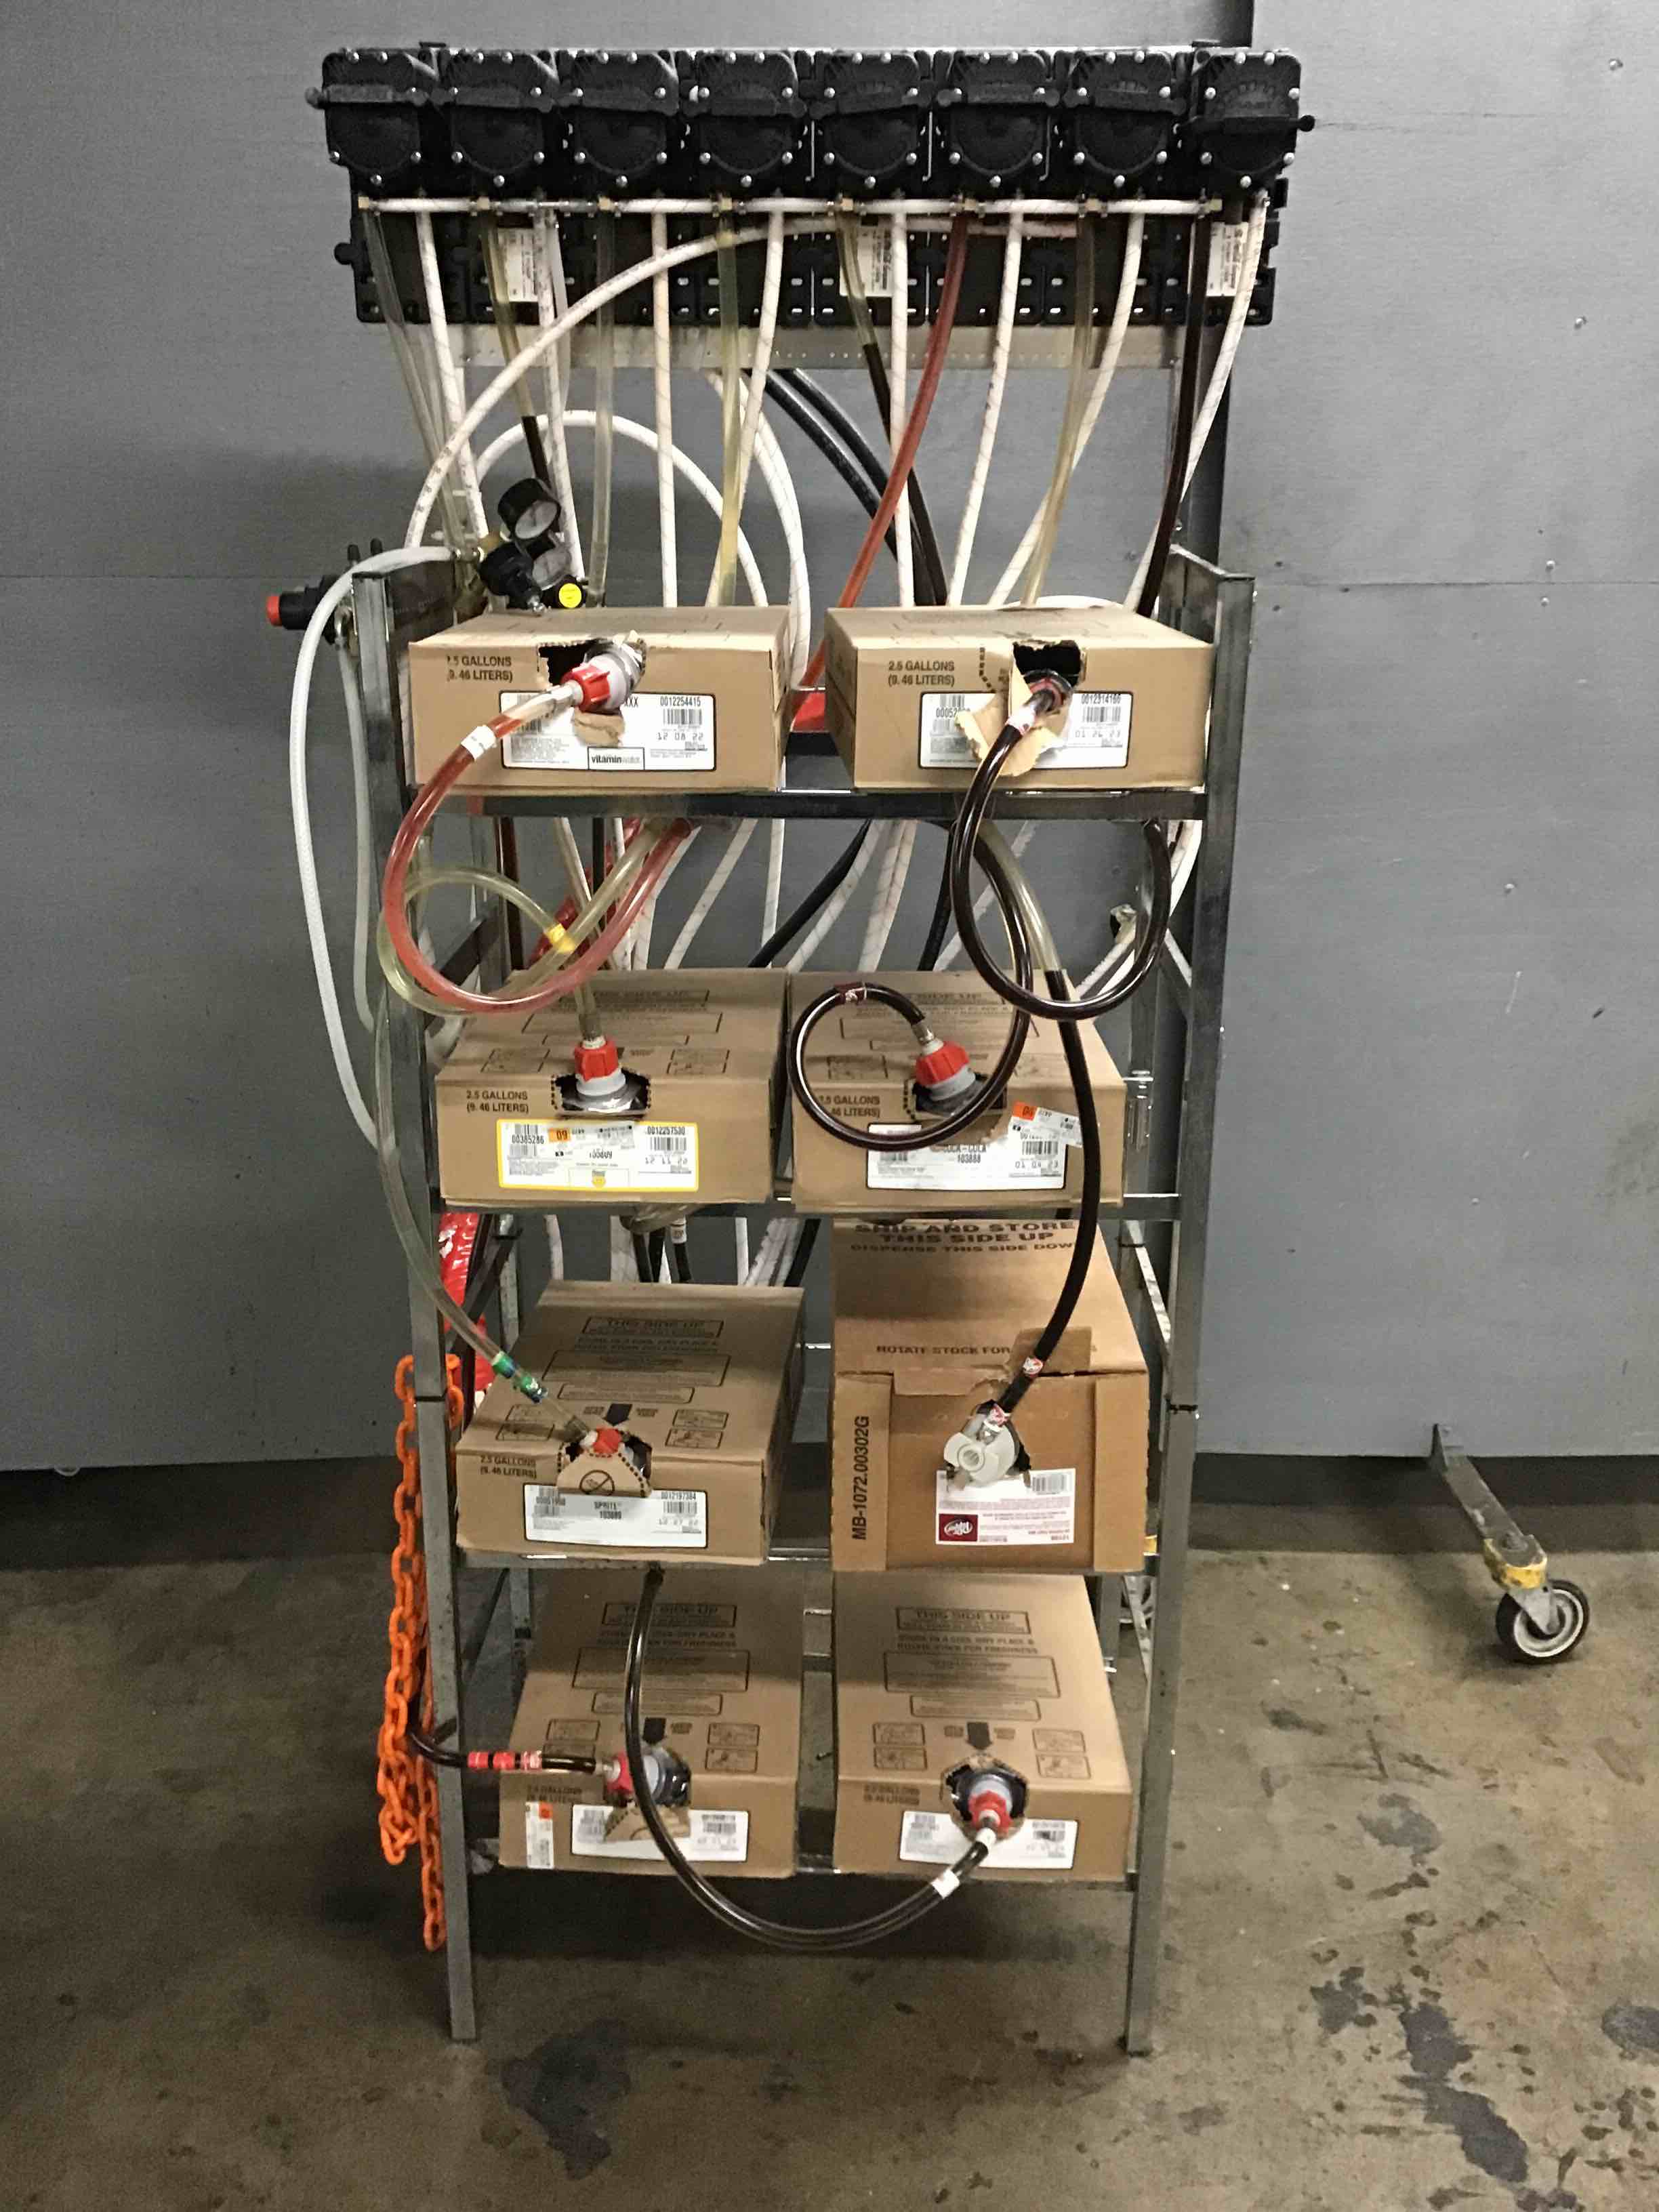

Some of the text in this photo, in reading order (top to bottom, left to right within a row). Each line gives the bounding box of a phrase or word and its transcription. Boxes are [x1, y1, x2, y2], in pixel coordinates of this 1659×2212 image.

[462, 656, 512, 666] GALLONS
[905, 661, 955, 671] GALLONS
[473, 670, 513, 683] LITERS)
[916, 674, 955, 687] LITERS)
[660, 697, 701, 706] 0012254415
[482, 1090, 528, 1101] GALLONS
[834, 1095, 880, 1105] GALLONS
[493, 1103, 529, 1115] LITERS)
[844, 1108, 880, 1118] LITERS)
[855, 1222, 1075, 1233] SHIP AND STORE
[881, 1233, 1054, 1244] THIS SIDE UP
[851, 1244, 937, 1252] DISPENSE
[1033, 1242, 1073, 1250] DOW
[876, 1345, 926, 1355] ROTATE
[931, 1346, 979, 1355] STOCK
[494, 1456, 536, 1467] GALLONS
[851, 1415, 869, 1541] MB-1072.00302G
